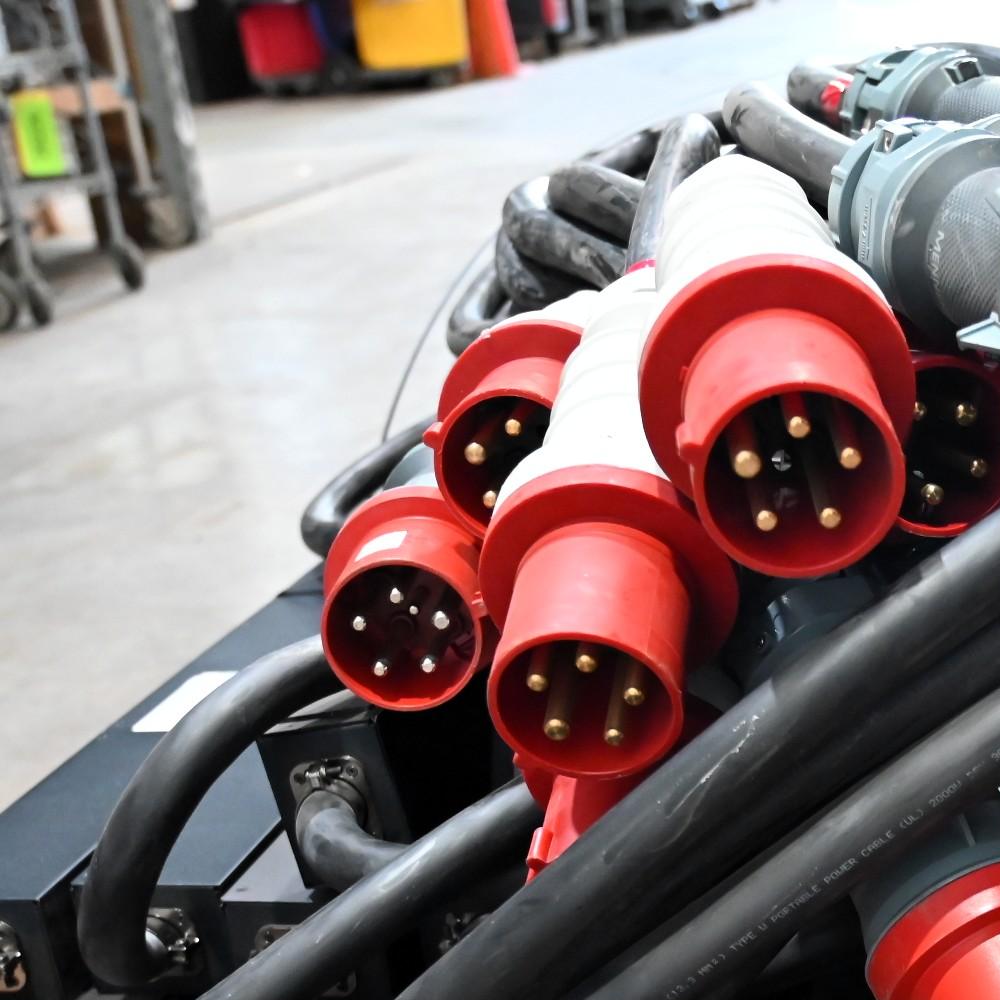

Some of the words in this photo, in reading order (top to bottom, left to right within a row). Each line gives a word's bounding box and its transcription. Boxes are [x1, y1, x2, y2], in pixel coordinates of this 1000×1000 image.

[729, 930, 757, 952] TYPE
[770, 884, 821, 923] PORTABLE
[823, 857, 858, 884] POWER
[860, 830, 896, 858] CABLE
[898, 808, 924, 830] (UL)
